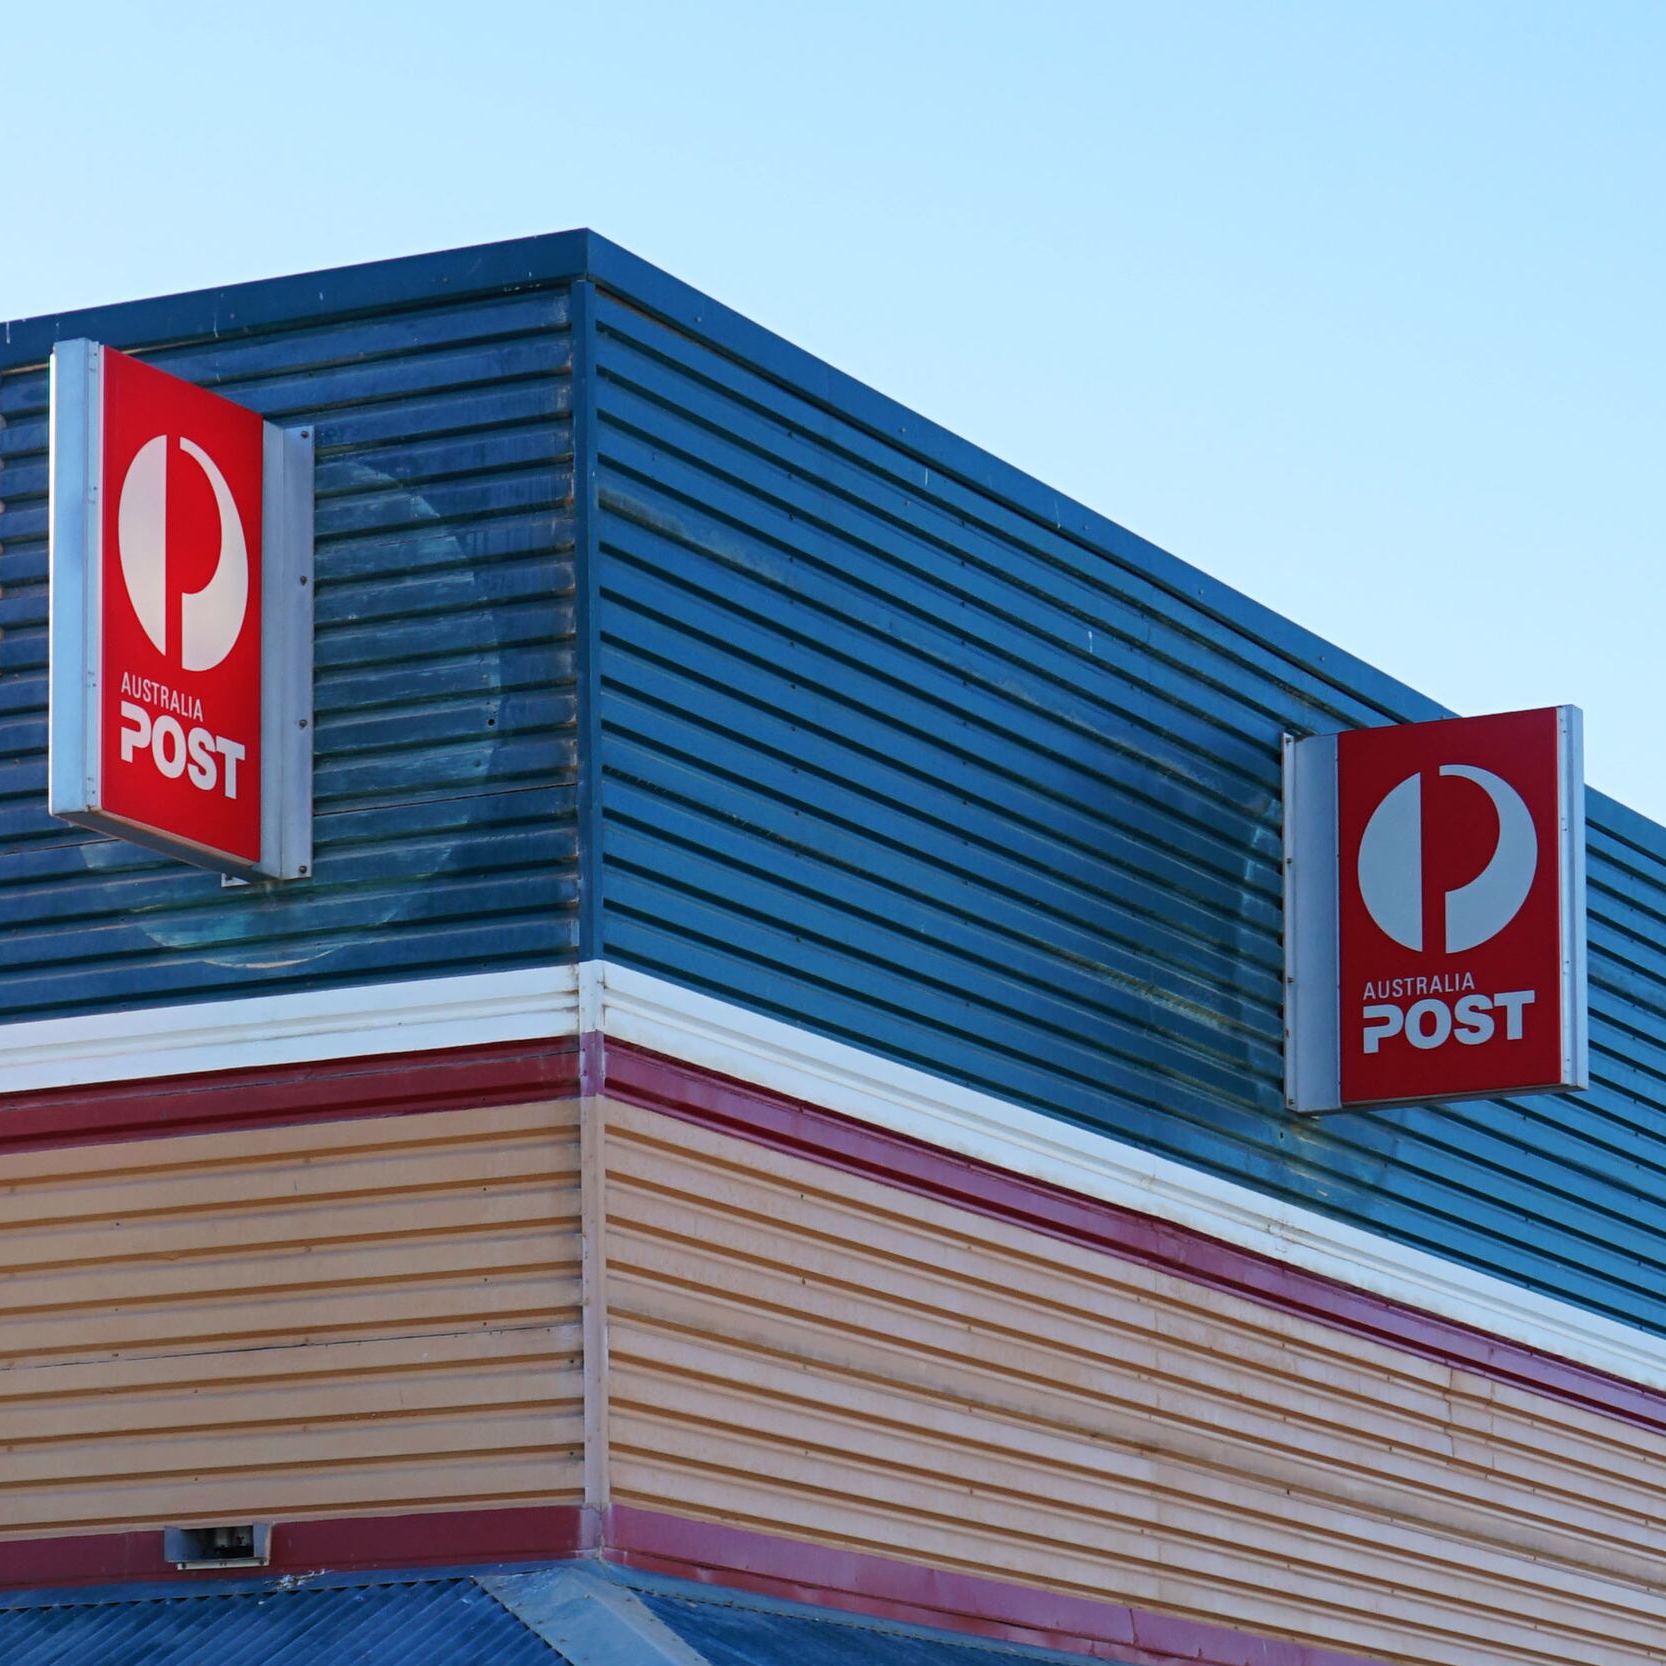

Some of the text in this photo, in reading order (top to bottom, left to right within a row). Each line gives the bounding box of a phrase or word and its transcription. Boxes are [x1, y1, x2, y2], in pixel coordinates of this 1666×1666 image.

[121, 671, 203, 723] AUSTRALIA
[120, 700, 245, 801] POST
[1363, 972, 1475, 1000] AUSTRALIA
[1363, 990, 1536, 1054] POST
